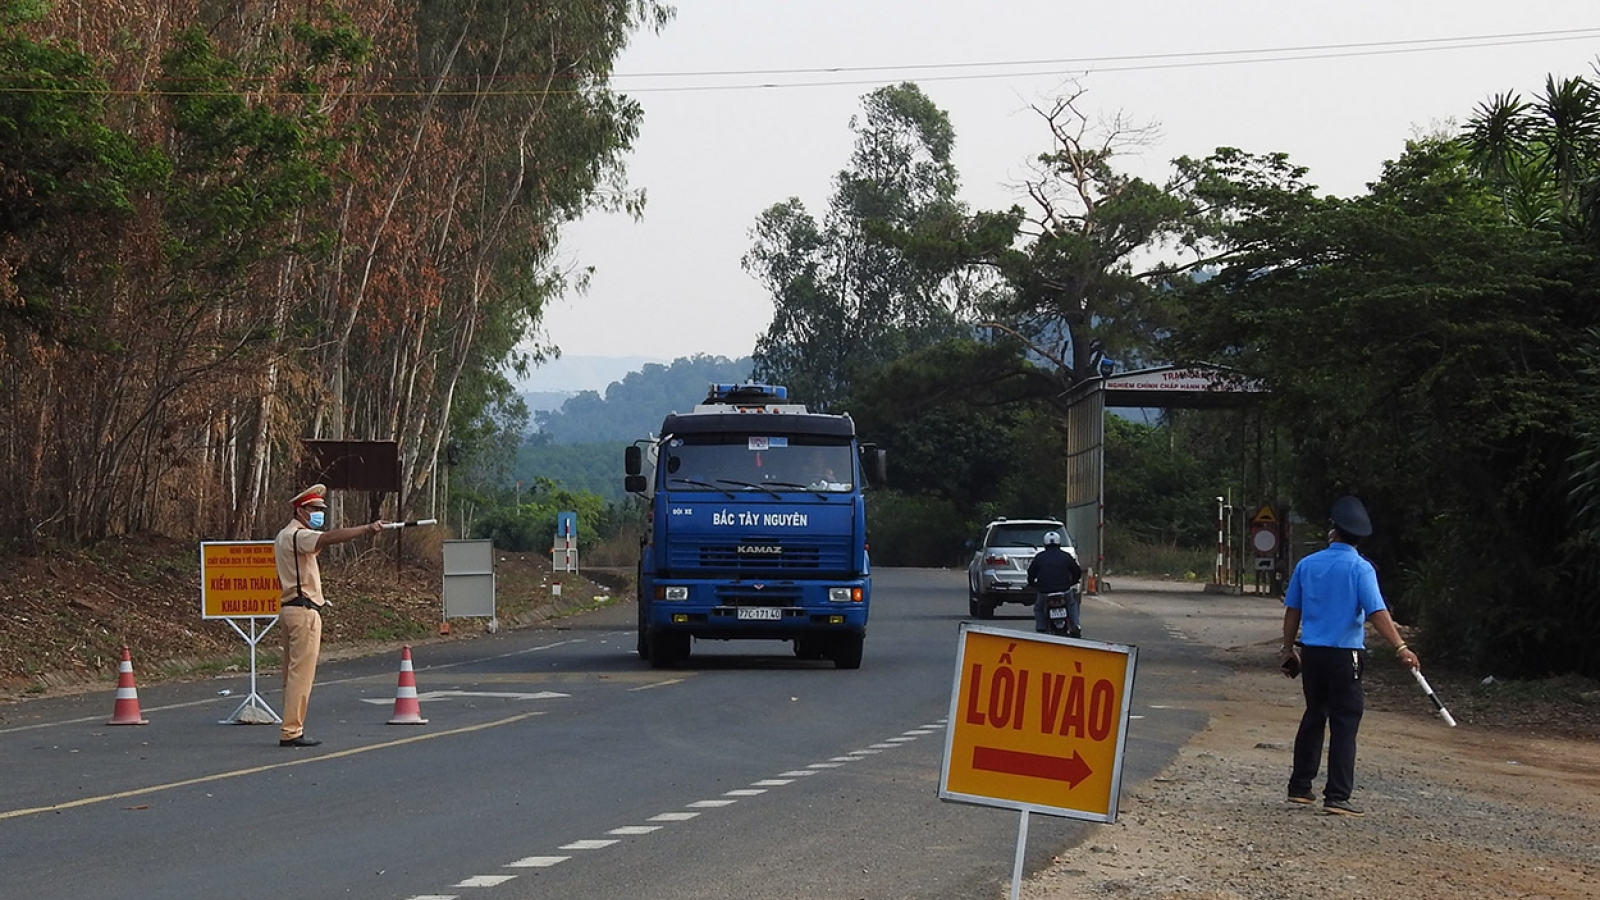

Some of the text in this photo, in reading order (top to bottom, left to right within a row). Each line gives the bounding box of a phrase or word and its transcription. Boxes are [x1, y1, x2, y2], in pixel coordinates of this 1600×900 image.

[713, 509, 807, 526] BẮC TÂY NGUYÊN
[233, 578, 247, 590] TRA
[250, 575, 270, 590] THÂN
[222, 600, 240, 612] KHAI
[260, 600, 265, 611] Y
[268, 597, 277, 611] TẾ
[966, 643, 1115, 742] LỐI VÀO
